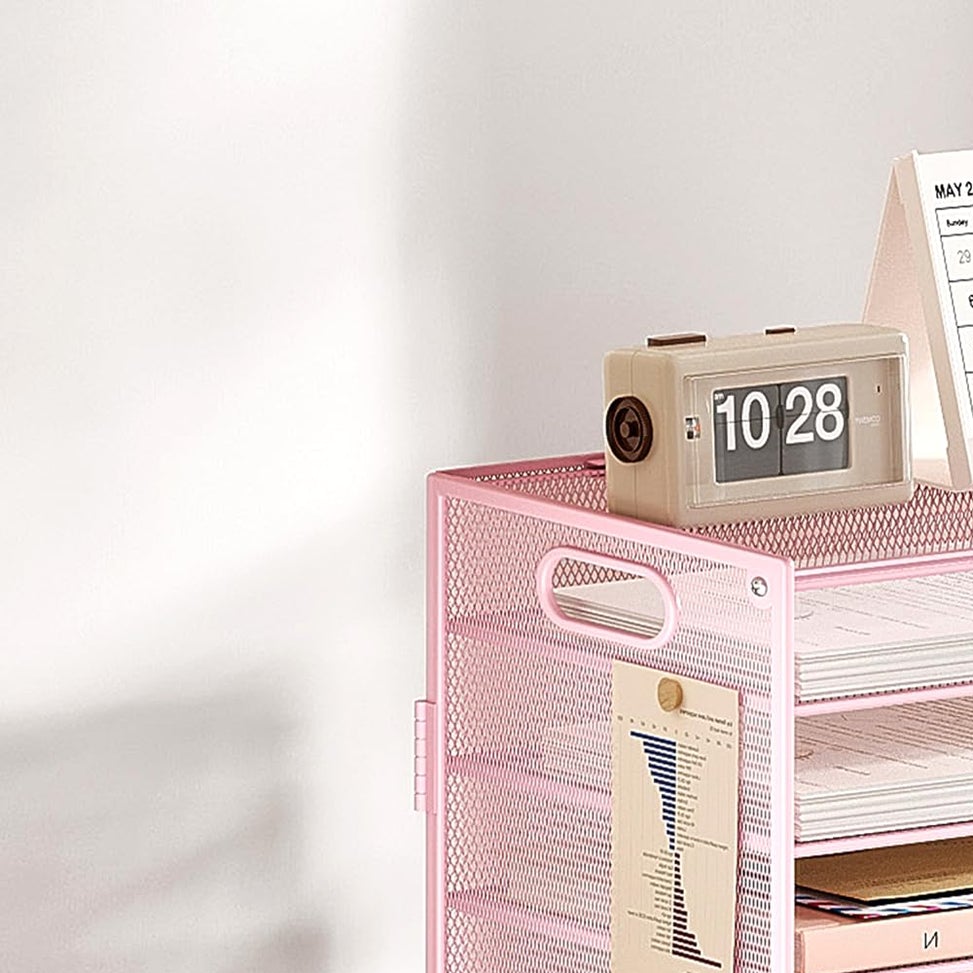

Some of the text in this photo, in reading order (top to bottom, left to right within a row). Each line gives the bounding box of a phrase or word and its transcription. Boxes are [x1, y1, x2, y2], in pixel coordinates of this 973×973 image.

[935, 182, 962, 199] MAY
[956, 248, 972, 265] 29
[716, 383, 845, 451] 10 28
